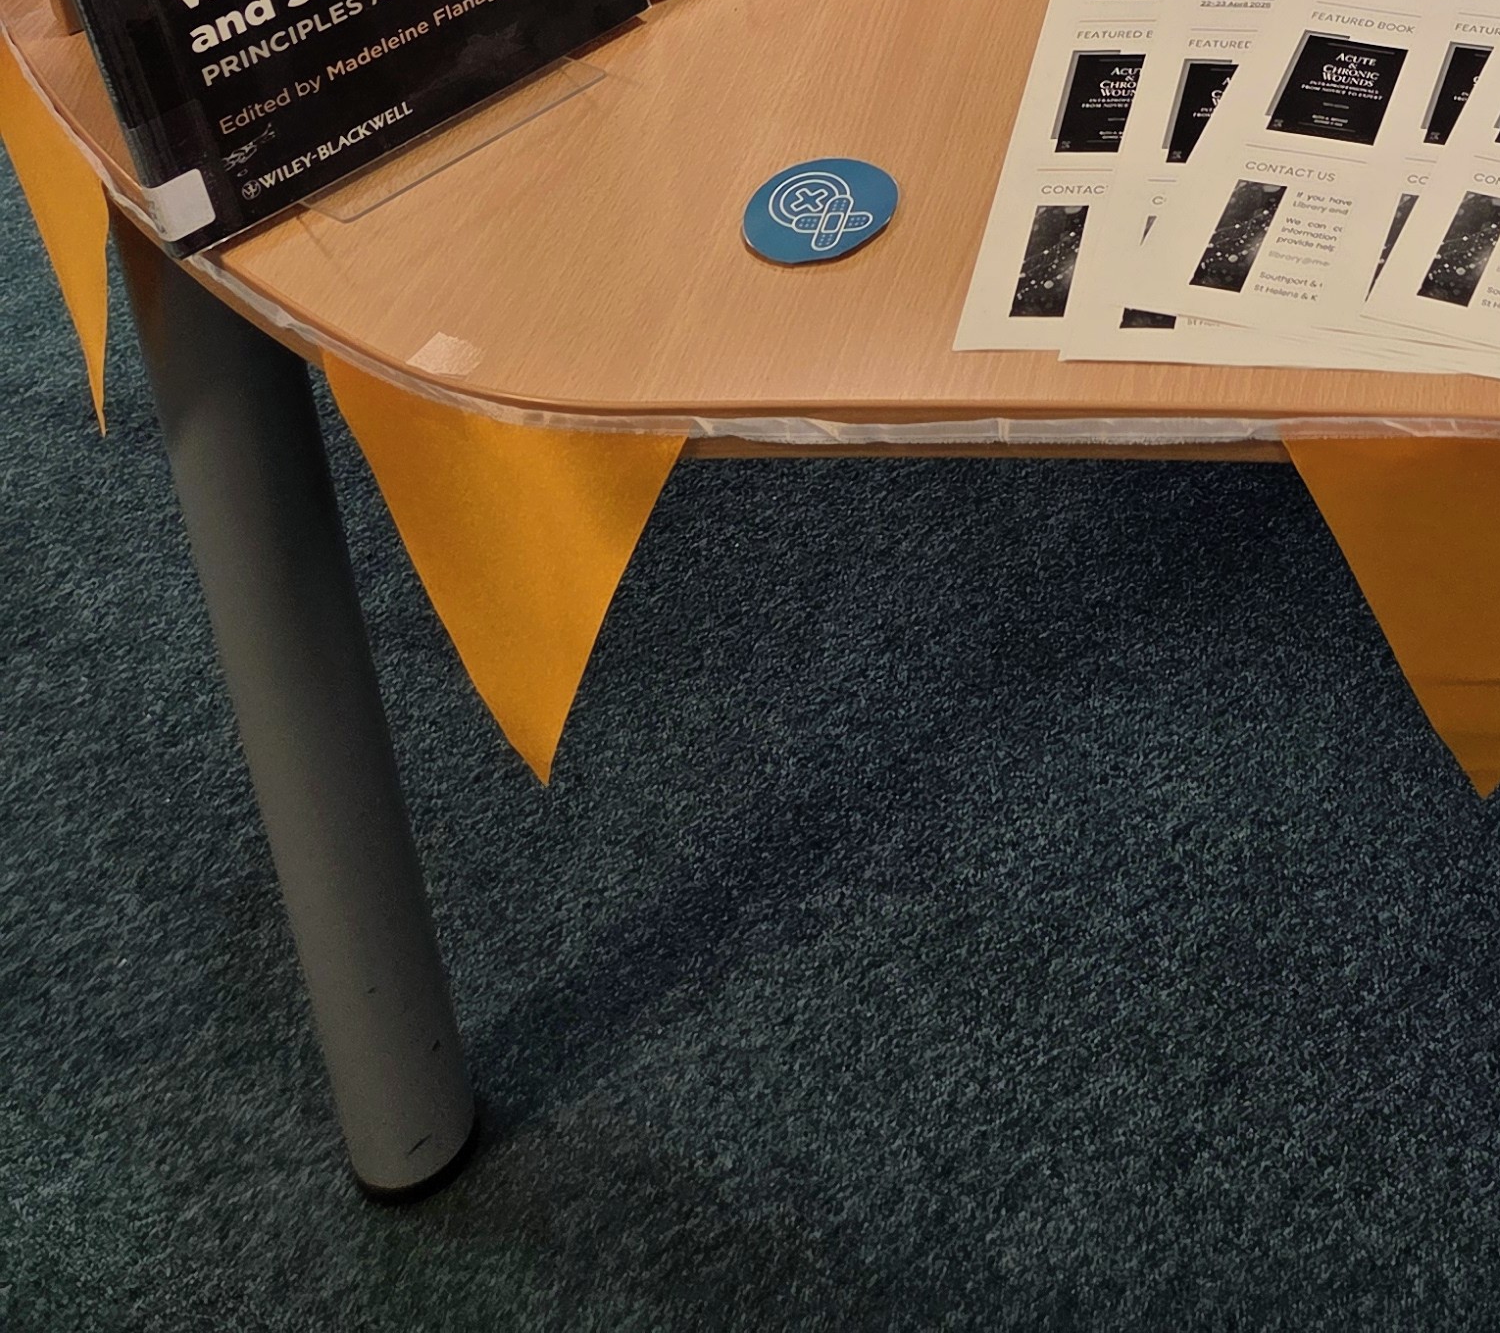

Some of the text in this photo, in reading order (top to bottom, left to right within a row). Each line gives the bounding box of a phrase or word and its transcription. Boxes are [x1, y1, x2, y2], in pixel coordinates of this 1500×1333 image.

[1310, 11, 1415, 35] FEATURED BOOK
[1335, 52, 1377, 67] ACUTE
[219, 88, 292, 136] Edited
[294, 75, 322, 98] by
[326, 20, 430, 81] Madeleine
[1323, 64, 1379, 82] CHRONIC
[1323, 71, 1374, 88] WOUNDS
[258, 101, 413, 191] WILEY-BLACKWELL
[1245, 160, 1337, 184] CONTACT US
